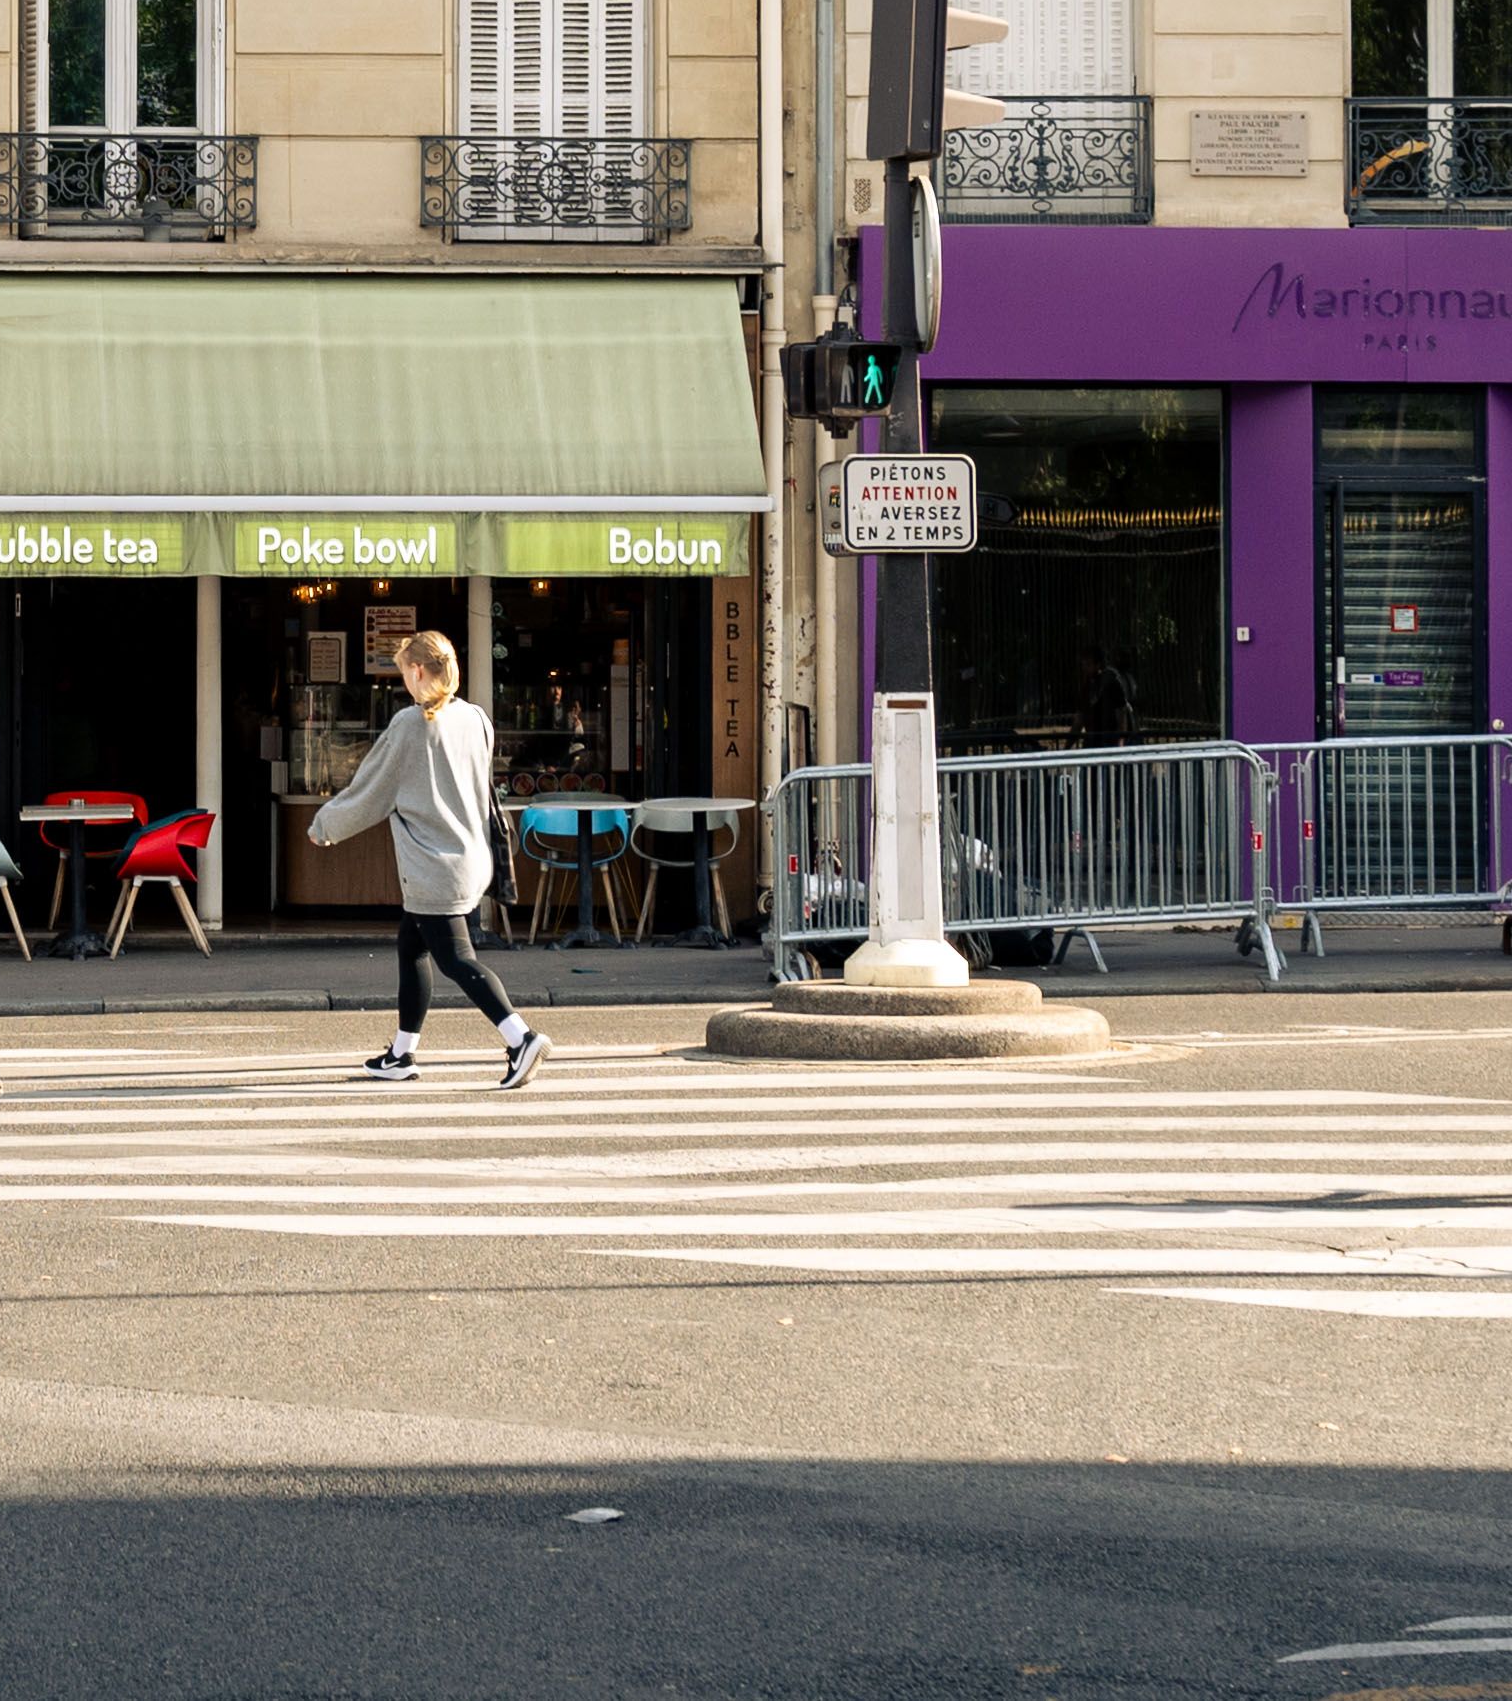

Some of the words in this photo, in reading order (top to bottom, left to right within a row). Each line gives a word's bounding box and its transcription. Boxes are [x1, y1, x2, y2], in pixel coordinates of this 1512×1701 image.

[1363, 334, 1437, 352] PARIS
[870, 463, 946, 481] PIÉTONS
[862, 486, 958, 500] ATTENTION
[257, 526, 346, 566] Poke
[353, 524, 438, 566] bowl
[856, 526, 878, 540] EN
[886, 526, 896, 540] 2
[904, 526, 964, 540] TEMPS
[101, 529, 159, 565] tea
[609, 527, 723, 567] Bobun
[724, 699, 740, 758] TEA
